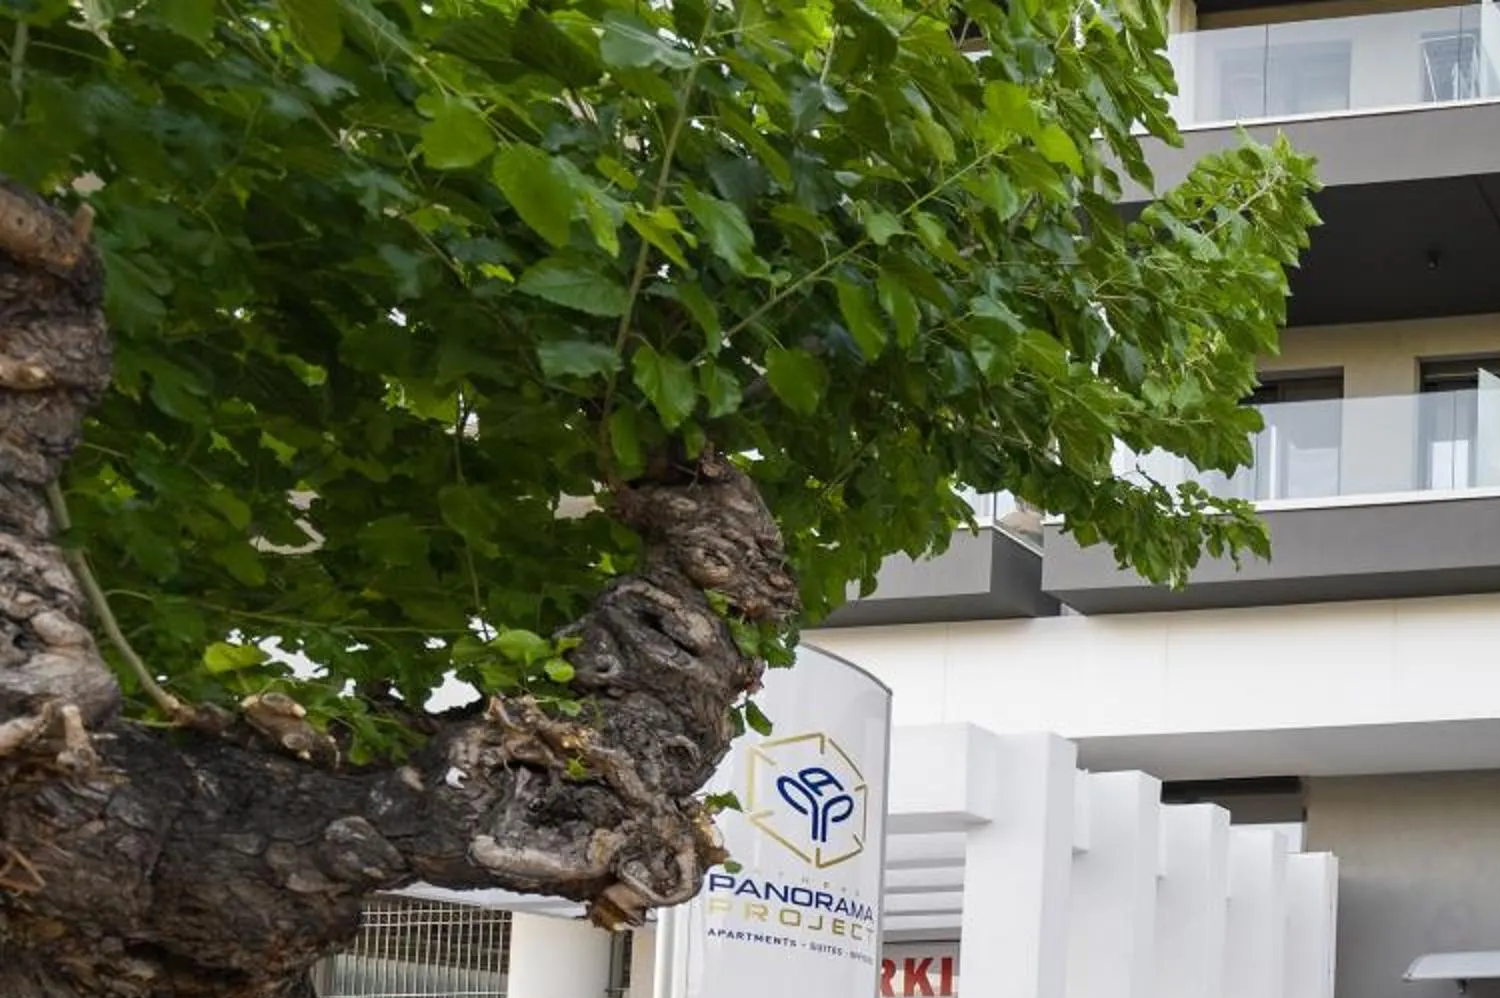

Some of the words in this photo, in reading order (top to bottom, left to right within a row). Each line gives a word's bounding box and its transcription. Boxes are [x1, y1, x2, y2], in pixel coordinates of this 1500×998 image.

[708, 897, 874, 942] PROJECT
[709, 873, 874, 921] PANORAMA
[708, 928, 797, 948] APARTMENTS
